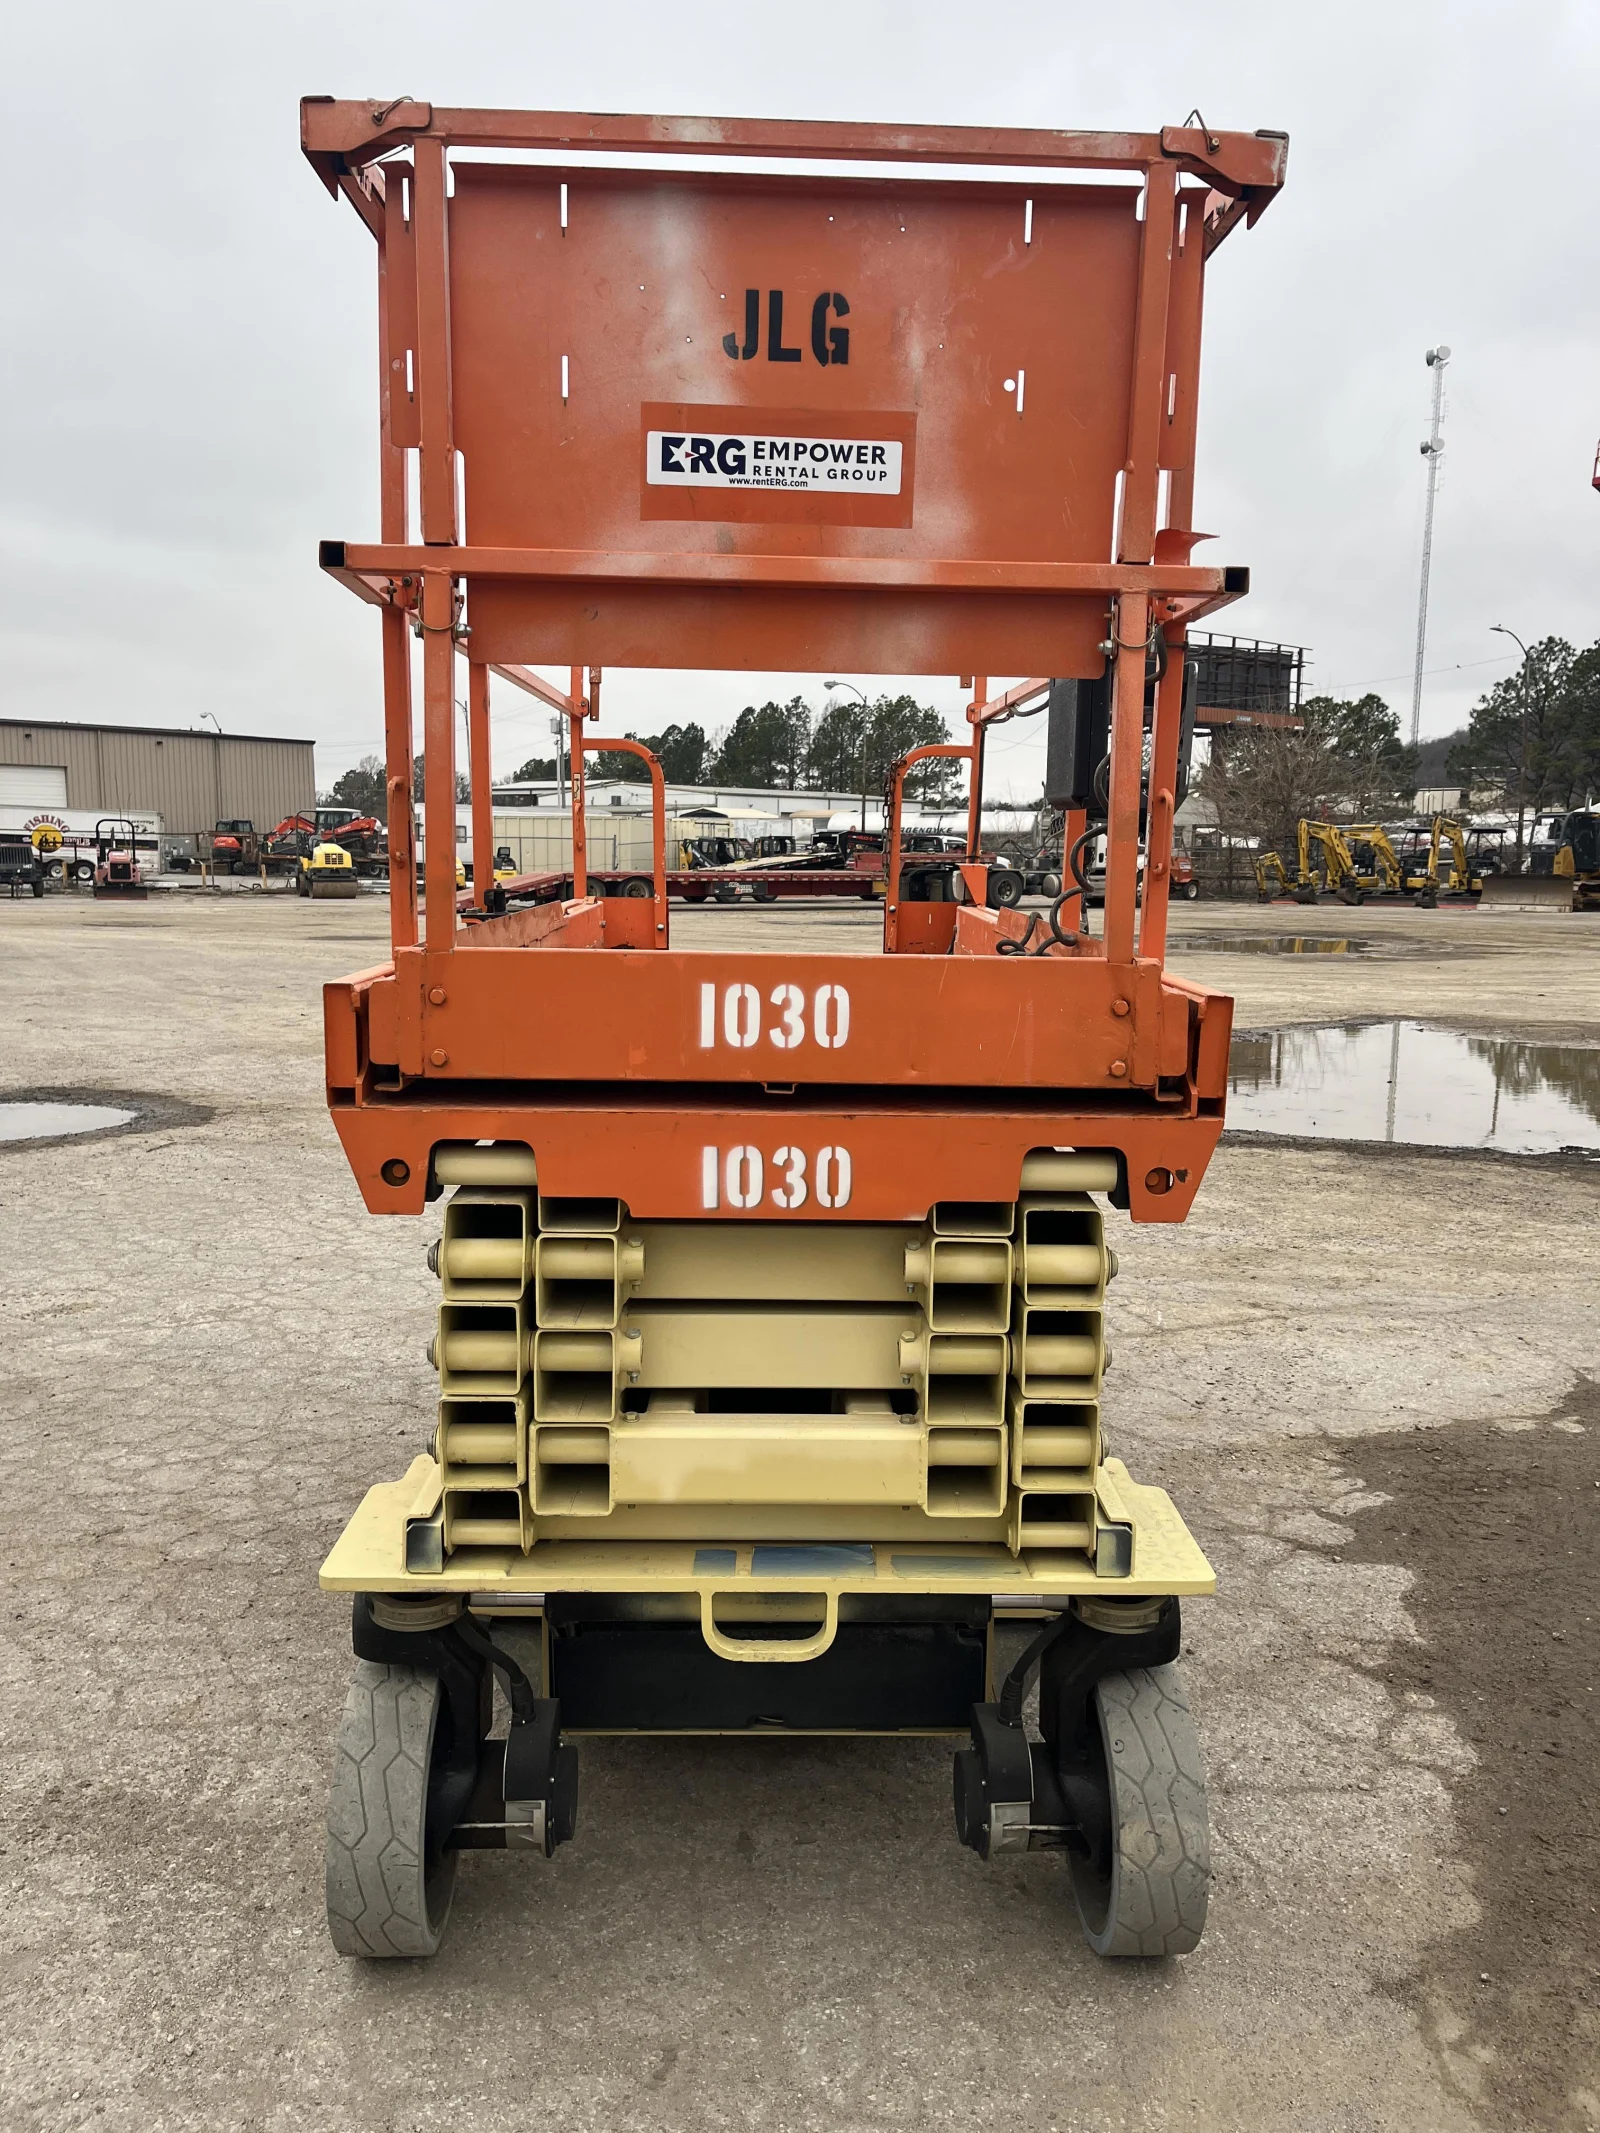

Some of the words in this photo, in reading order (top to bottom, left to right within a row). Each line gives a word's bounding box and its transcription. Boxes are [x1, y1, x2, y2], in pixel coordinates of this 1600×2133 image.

[722, 289, 850, 367] JLG
[661, 436, 746, 476] ERG
[753, 440, 887, 465] EMPOWER
[752, 465, 820, 479] RENTAL
[826, 468, 888, 482] GROUP
[728, 477, 809, 488] www.rentERG.com
[23, 814, 71, 833] FISHING
[700, 983, 850, 1048] 1030
[702, 1145, 852, 1209] 1030
